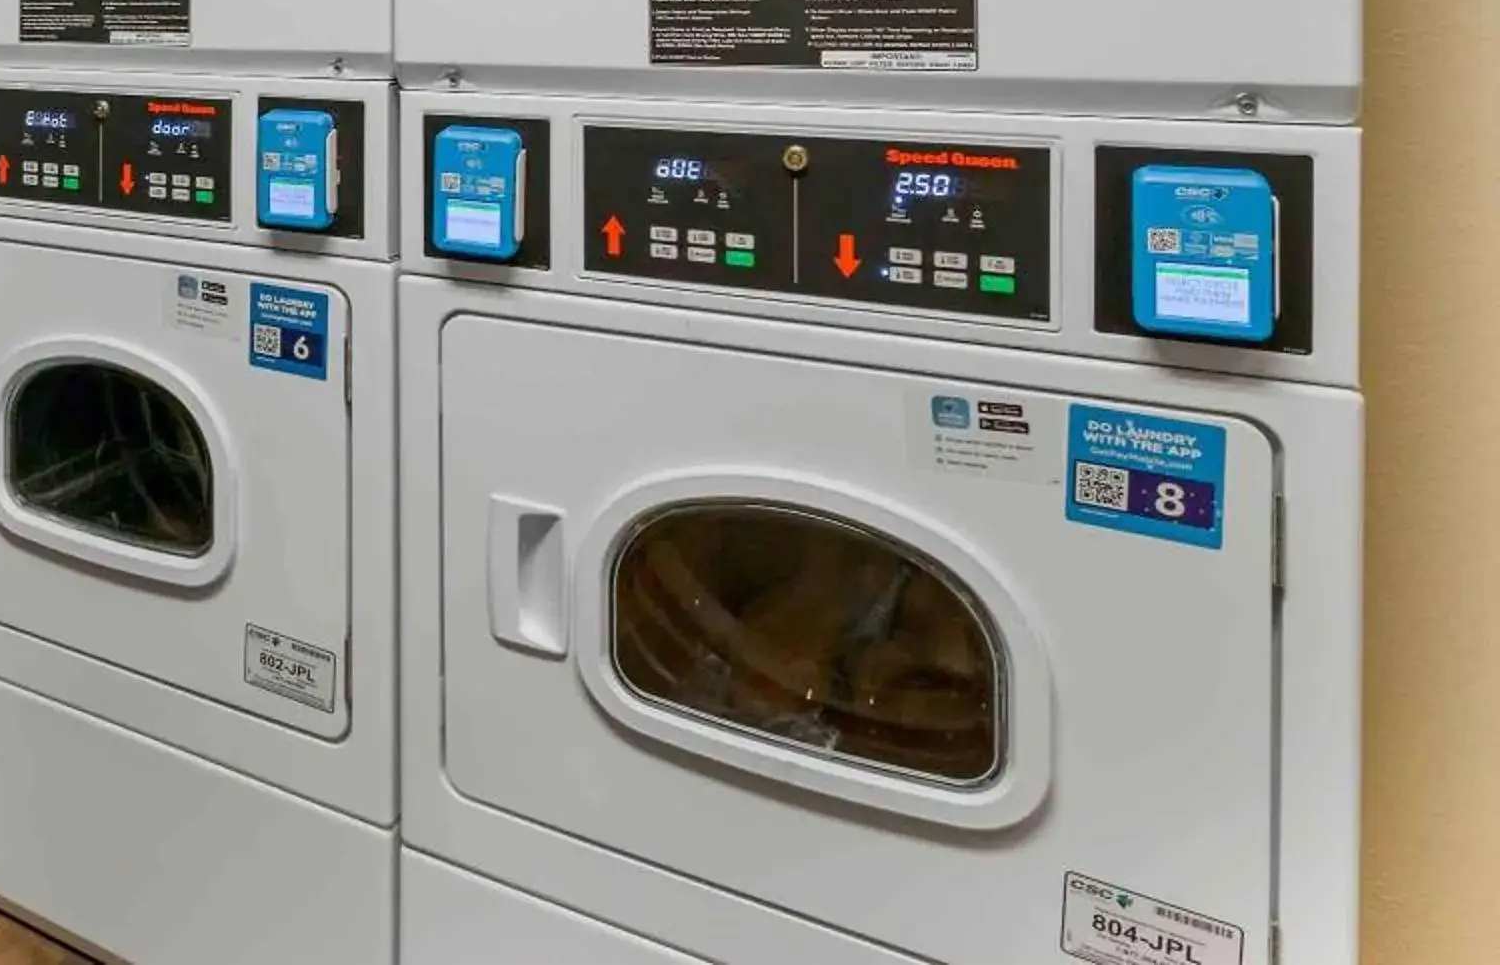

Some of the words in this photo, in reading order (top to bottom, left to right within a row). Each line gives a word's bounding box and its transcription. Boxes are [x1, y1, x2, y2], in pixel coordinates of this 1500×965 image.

[148, 101, 181, 114] Speed
[152, 120, 190, 136] door
[885, 148, 949, 165] Speed
[950, 152, 1018, 169] Queen
[895, 172, 951, 196] 2.50
[293, 334, 310, 361] 6
[1083, 429, 1127, 447] WITH
[1130, 437, 1163, 454] THE
[1166, 443, 1202, 460] APP
[1087, 420, 1113, 434] DO
[1116, 424, 1197, 447] LAUNDRY
[1155, 481, 1186, 518] 8
[259, 651, 316, 683] 802-JPL
[1069, 879, 1115, 901] CSC
[1091, 913, 1203, 965] 804-JPL
